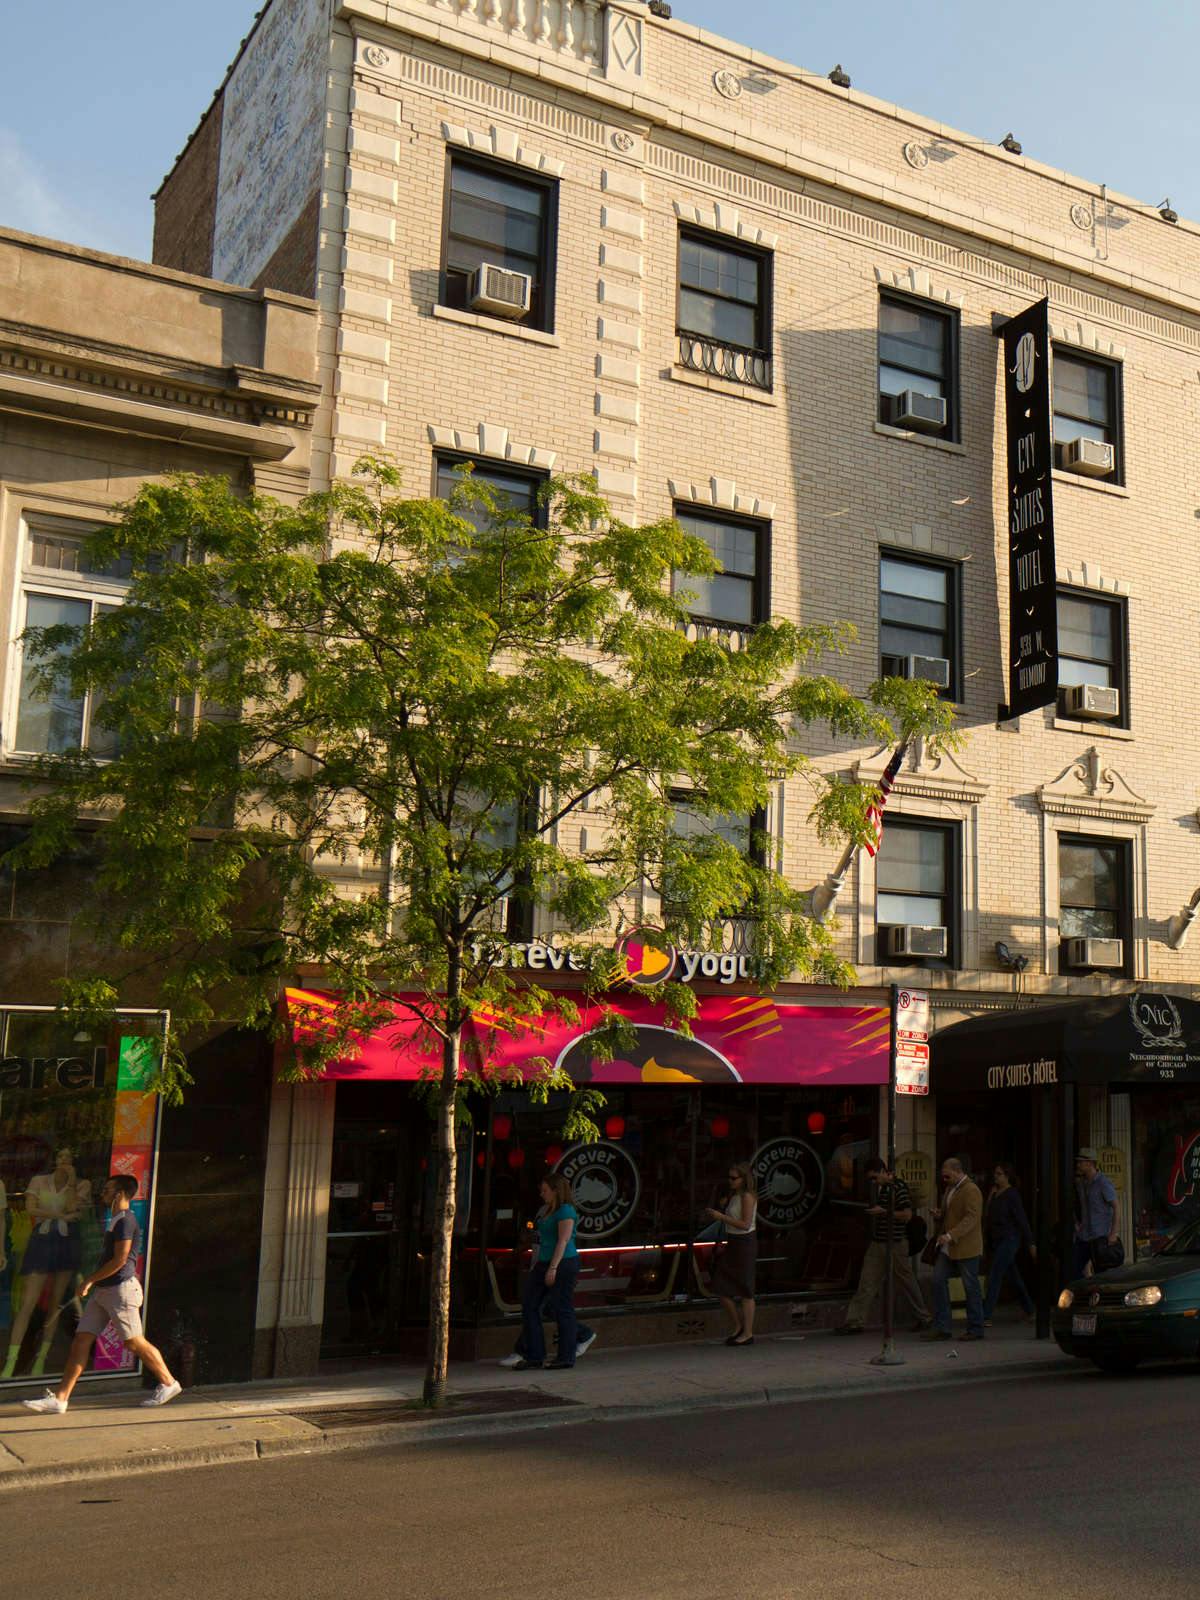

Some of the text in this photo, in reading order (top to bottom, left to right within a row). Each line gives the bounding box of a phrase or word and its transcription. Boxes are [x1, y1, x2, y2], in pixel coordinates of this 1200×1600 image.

[1018, 431, 1036, 475] CITY
[1011, 487, 1044, 535] SUITES
[1017, 548, 1045, 592] HOTEL
[1019, 661, 1048, 691] BELMONT
[470, 938, 597, 971] foreve
[987, 1065, 1005, 1089] CITY
[1005, 1063, 1032, 1088] SUITES
[562, 1149, 617, 1184] orever
